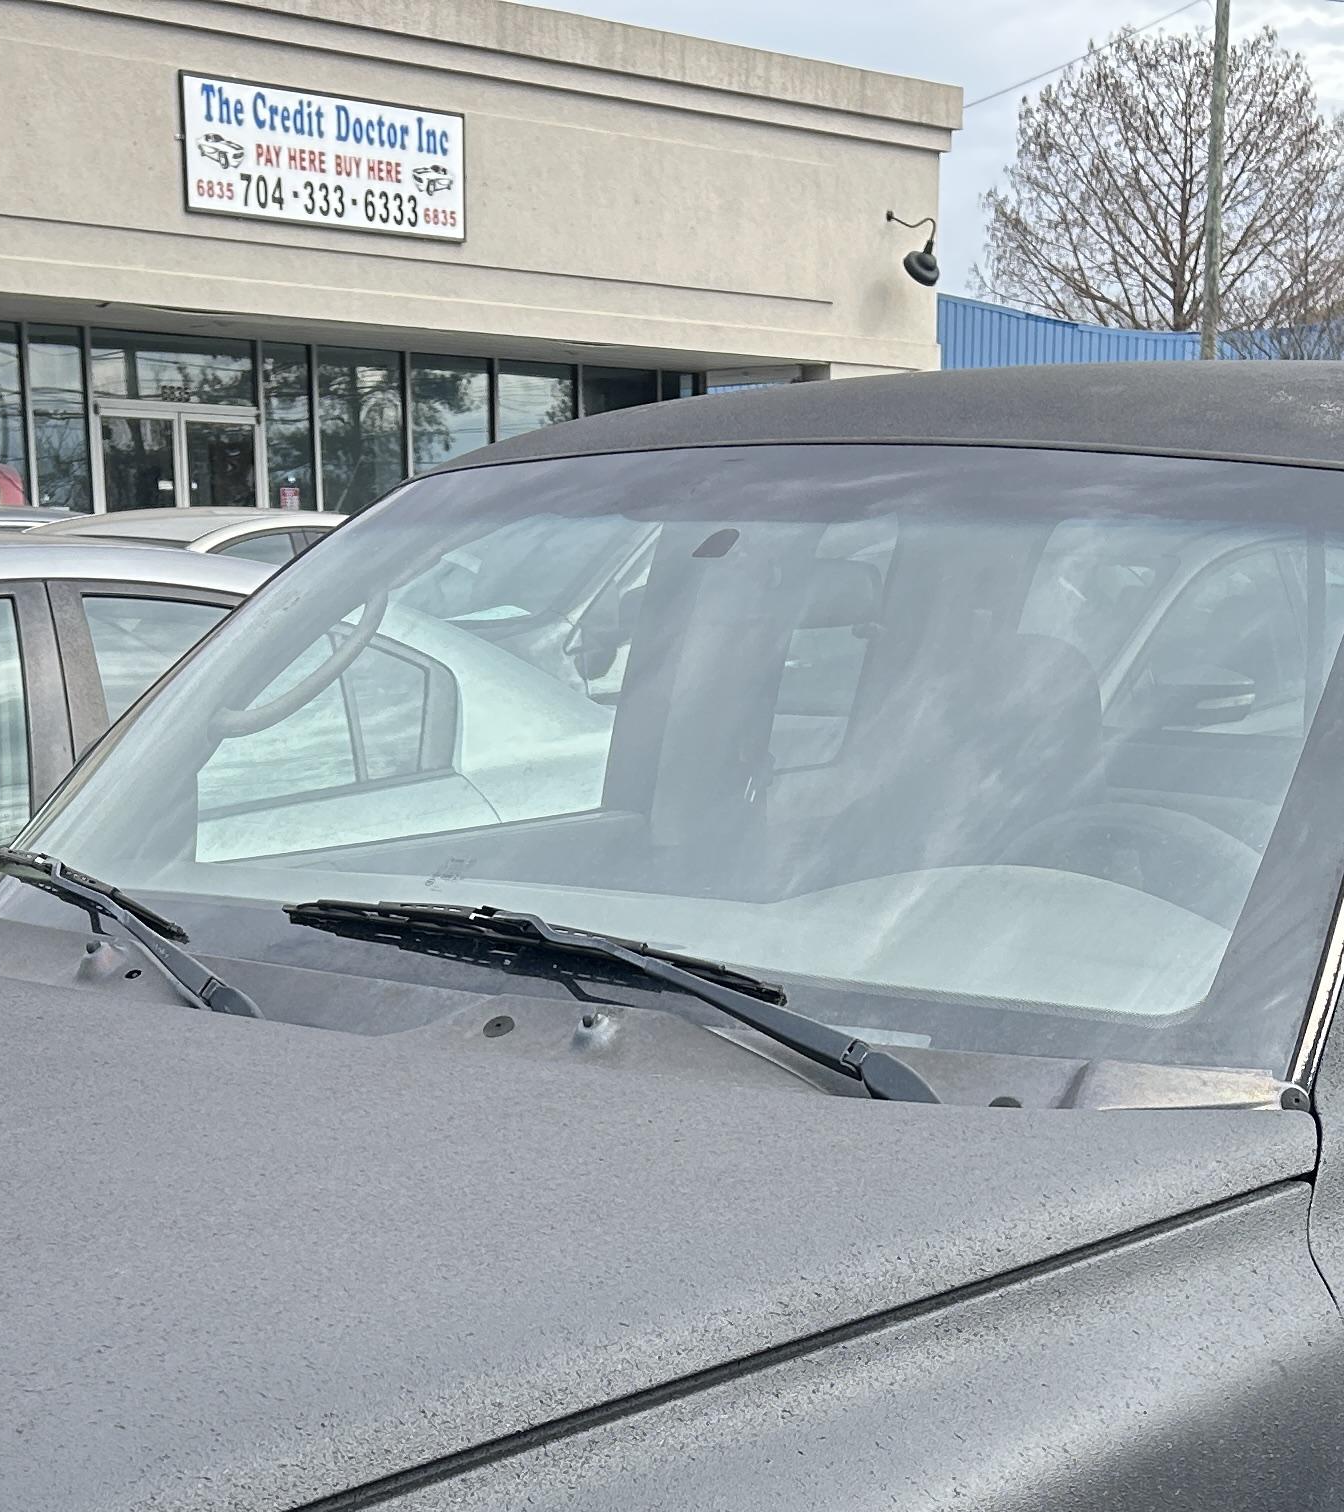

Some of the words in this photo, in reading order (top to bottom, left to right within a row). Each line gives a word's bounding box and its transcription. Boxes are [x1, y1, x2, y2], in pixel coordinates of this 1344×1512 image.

[201, 82, 245, 127] The
[253, 91, 325, 139] Credit
[335, 104, 410, 151] Doctor
[416, 117, 449, 157] Inc
[255, 143, 282, 169] PAY
[288, 147, 327, 174] HERE
[335, 154, 361, 180] BUY
[367, 158, 403, 184] HERE
[196, 178, 235, 200] 6835
[423, 207, 457, 227] 6835
